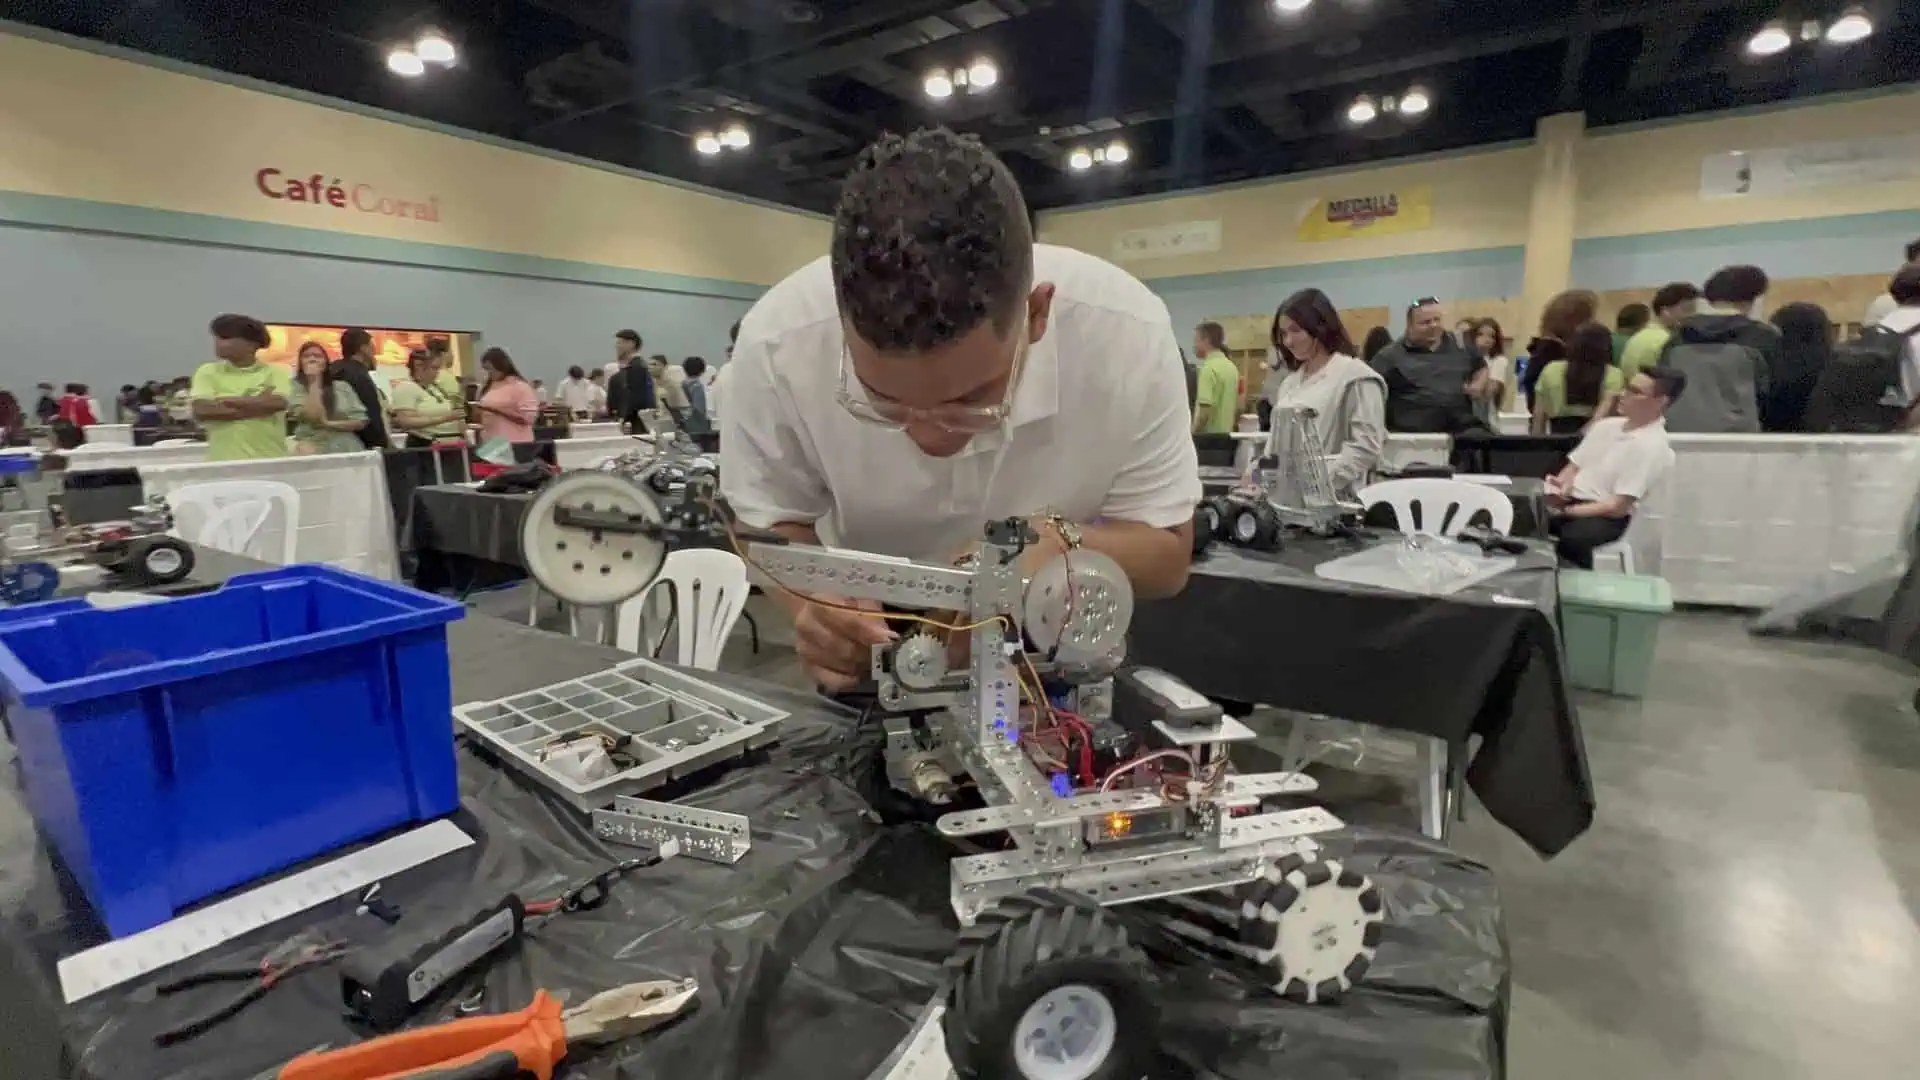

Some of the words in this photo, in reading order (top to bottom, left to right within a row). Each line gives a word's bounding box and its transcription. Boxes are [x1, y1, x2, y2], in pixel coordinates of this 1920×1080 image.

[256, 167, 346, 209] Café
[352, 183, 439, 222] Coral
[1327, 193, 1398, 217] MEDALLA
